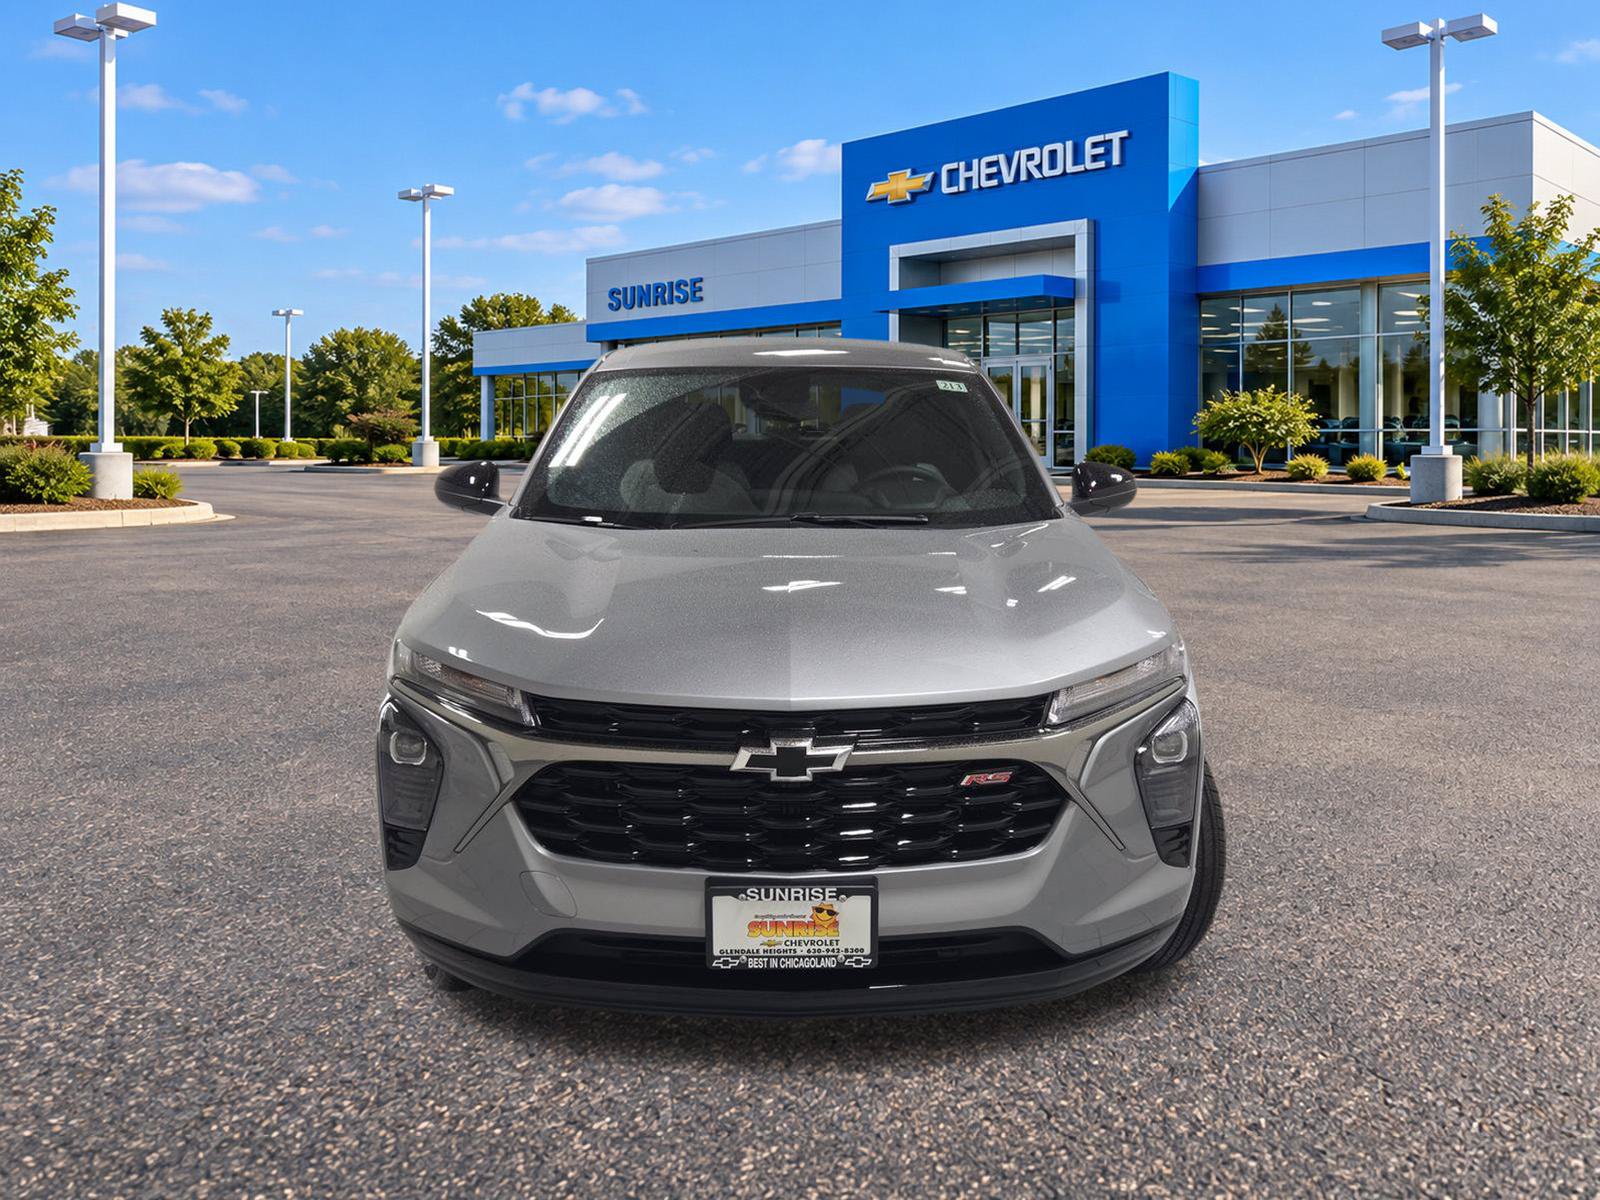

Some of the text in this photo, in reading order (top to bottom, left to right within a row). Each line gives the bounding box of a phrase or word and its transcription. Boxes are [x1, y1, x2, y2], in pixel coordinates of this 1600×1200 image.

[941, 130, 1129, 195] CHEVROLET
[608, 277, 704, 312] SUNRISE
[960, 771, 1013, 786] RS
[746, 887, 838, 901] SUNRISE
[747, 920, 840, 938] SUNRISE
[784, 939, 840, 947] CHEVROLET
[748, 957, 837, 969] BEST IN CHICAGOLAND
